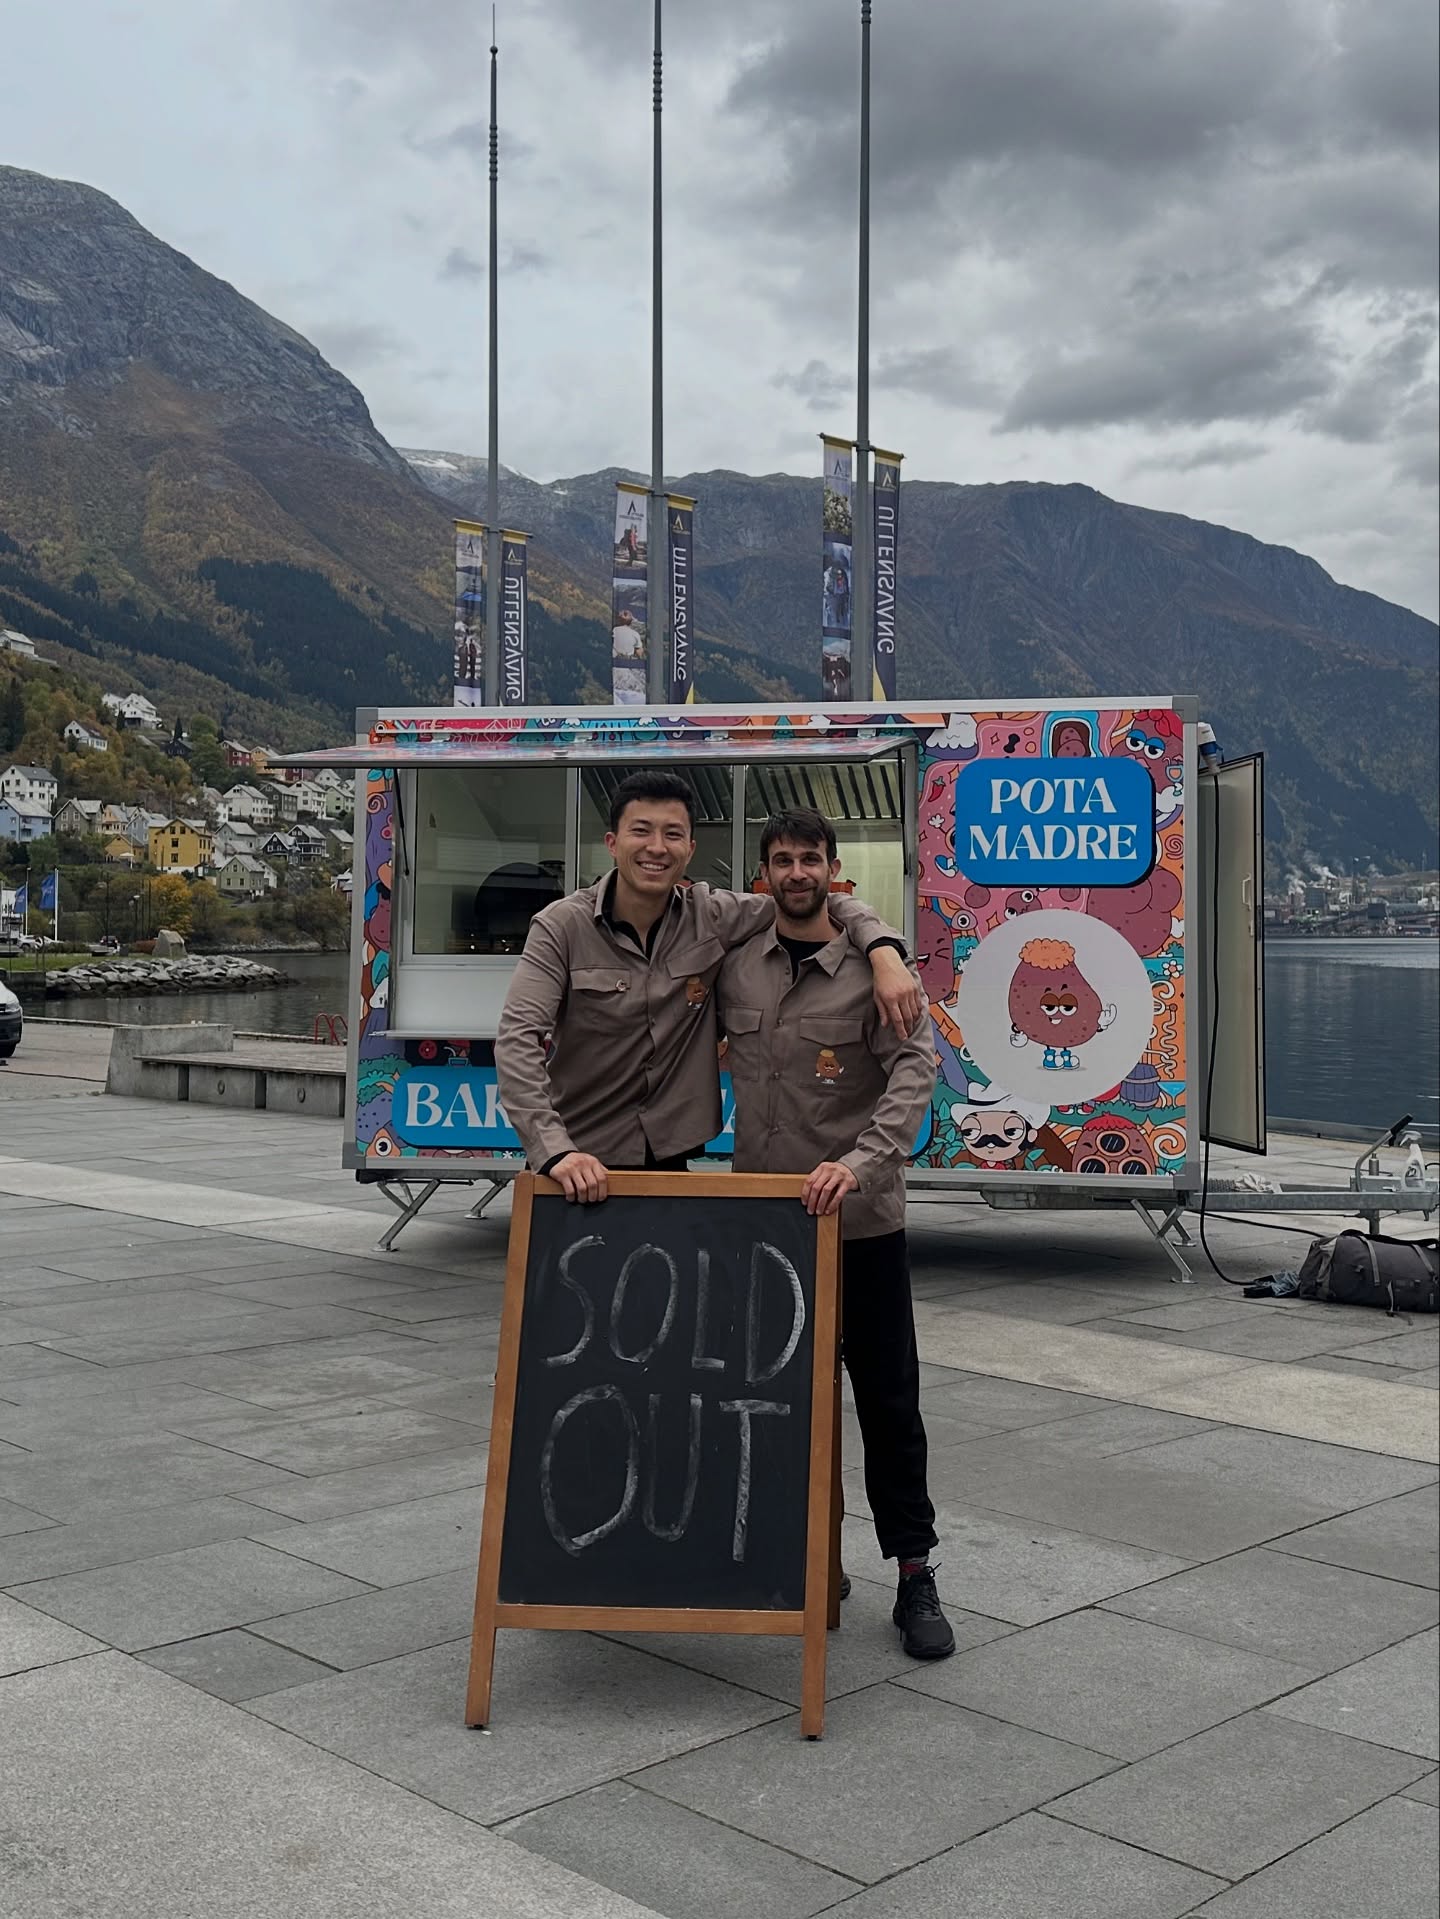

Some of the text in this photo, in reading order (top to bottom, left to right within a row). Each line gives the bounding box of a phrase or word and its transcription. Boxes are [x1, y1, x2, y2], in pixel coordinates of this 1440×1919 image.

[674, 547, 687, 681] ULLENSVANG
[969, 824, 1138, 860] MADRE
[990, 777, 1117, 815] POTA
[540, 1233, 806, 1387] SOLD
[540, 1383, 791, 1563] OUT
